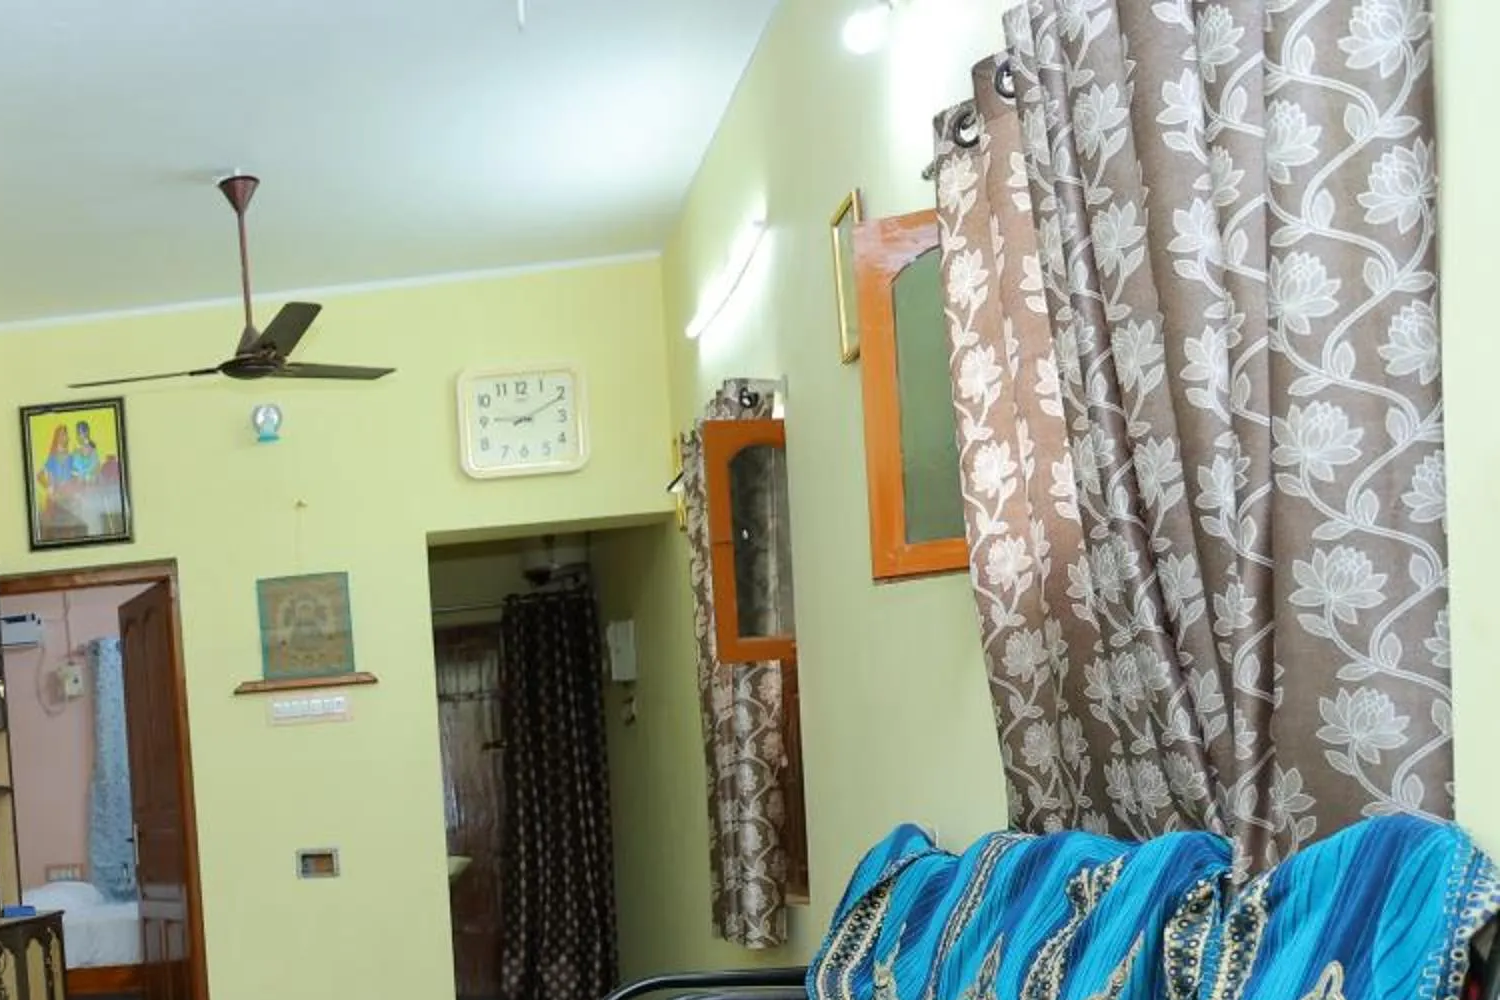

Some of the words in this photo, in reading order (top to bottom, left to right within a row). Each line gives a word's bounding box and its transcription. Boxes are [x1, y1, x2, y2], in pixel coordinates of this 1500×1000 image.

[496, 383, 507, 397] 11
[515, 381, 527, 395] 12
[556, 385, 565, 400] 2
[477, 394, 491, 408] 10
[479, 416, 489, 429] 9
[557, 408, 567, 423] 3
[558, 431, 566, 444] 4
[501, 444, 510, 459] 7
[518, 444, 529, 458] 6
